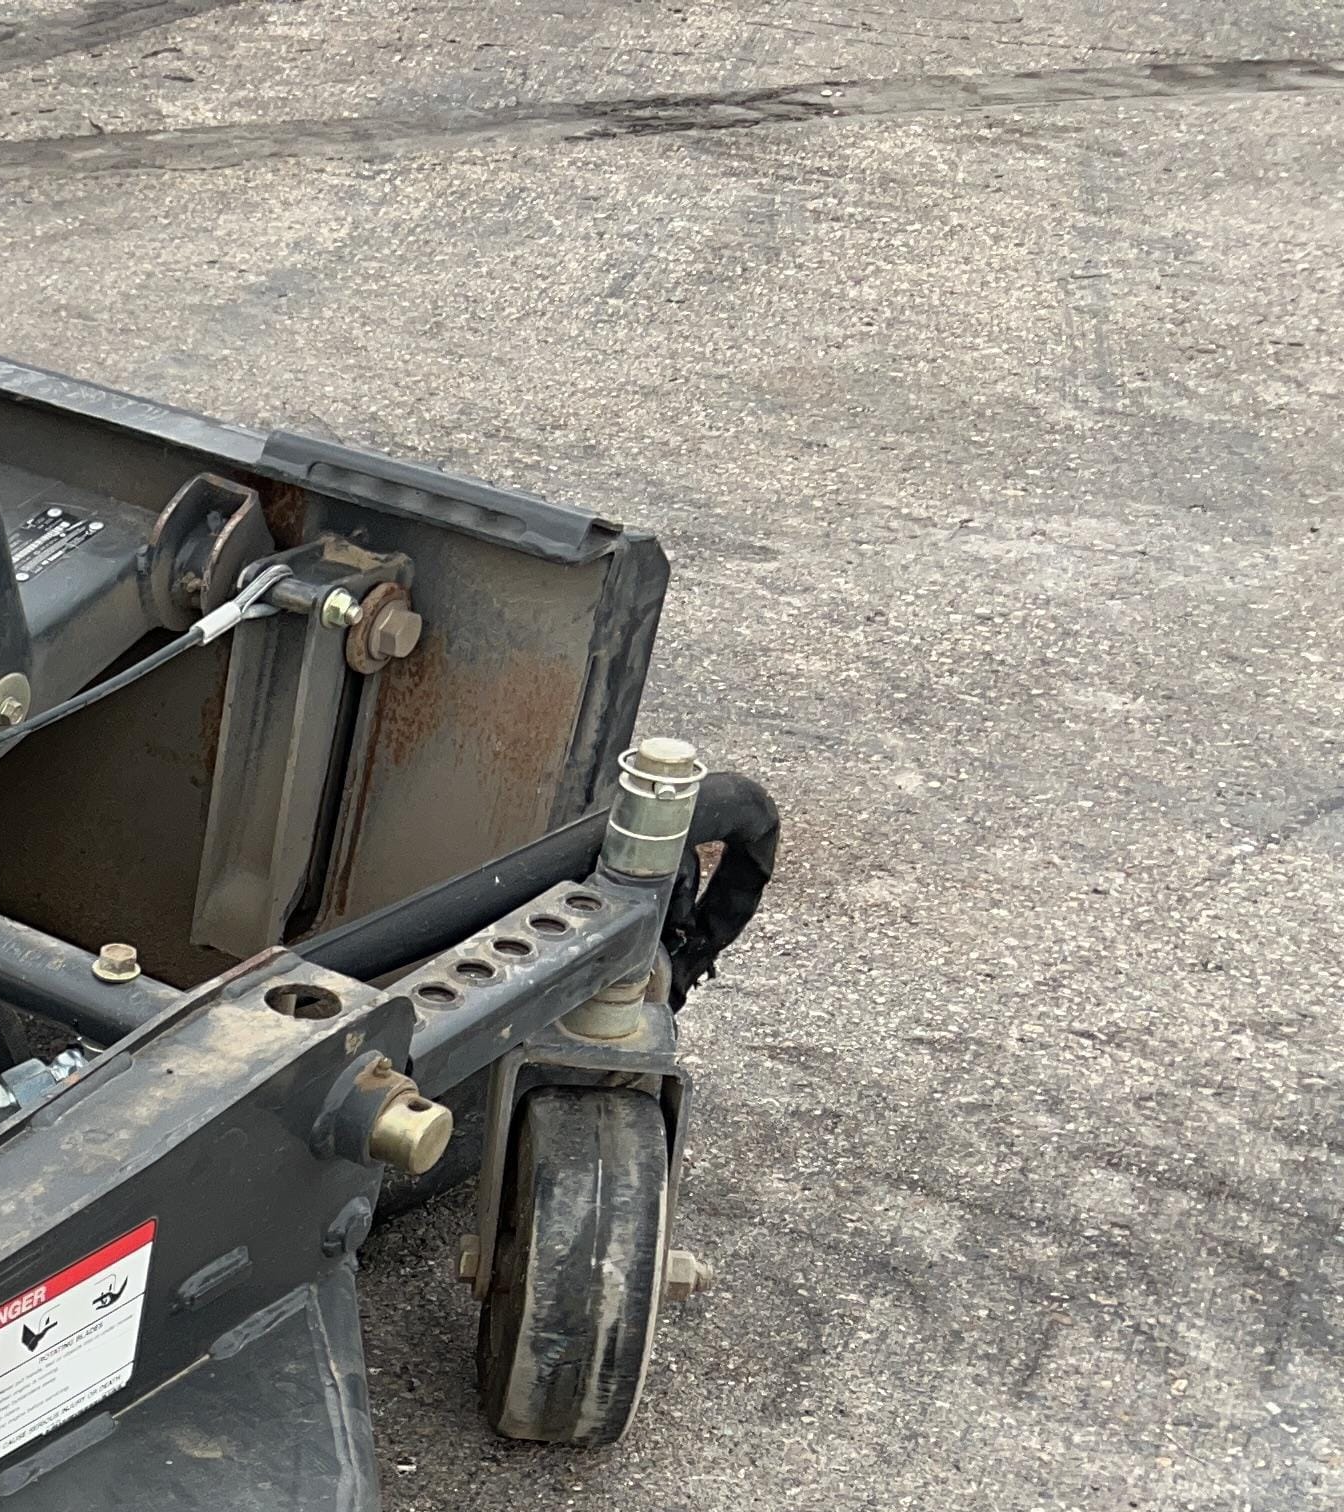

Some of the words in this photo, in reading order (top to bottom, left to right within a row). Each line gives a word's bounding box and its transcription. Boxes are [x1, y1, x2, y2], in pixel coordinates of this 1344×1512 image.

[38, 1337, 74, 1364] ROTATING
[75, 1319, 103, 1343] BLADES
[2, 1429, 26, 1450] CAUSE
[86, 1386, 97, 1399] OR
[98, 1372, 121, 1392] DEATH
